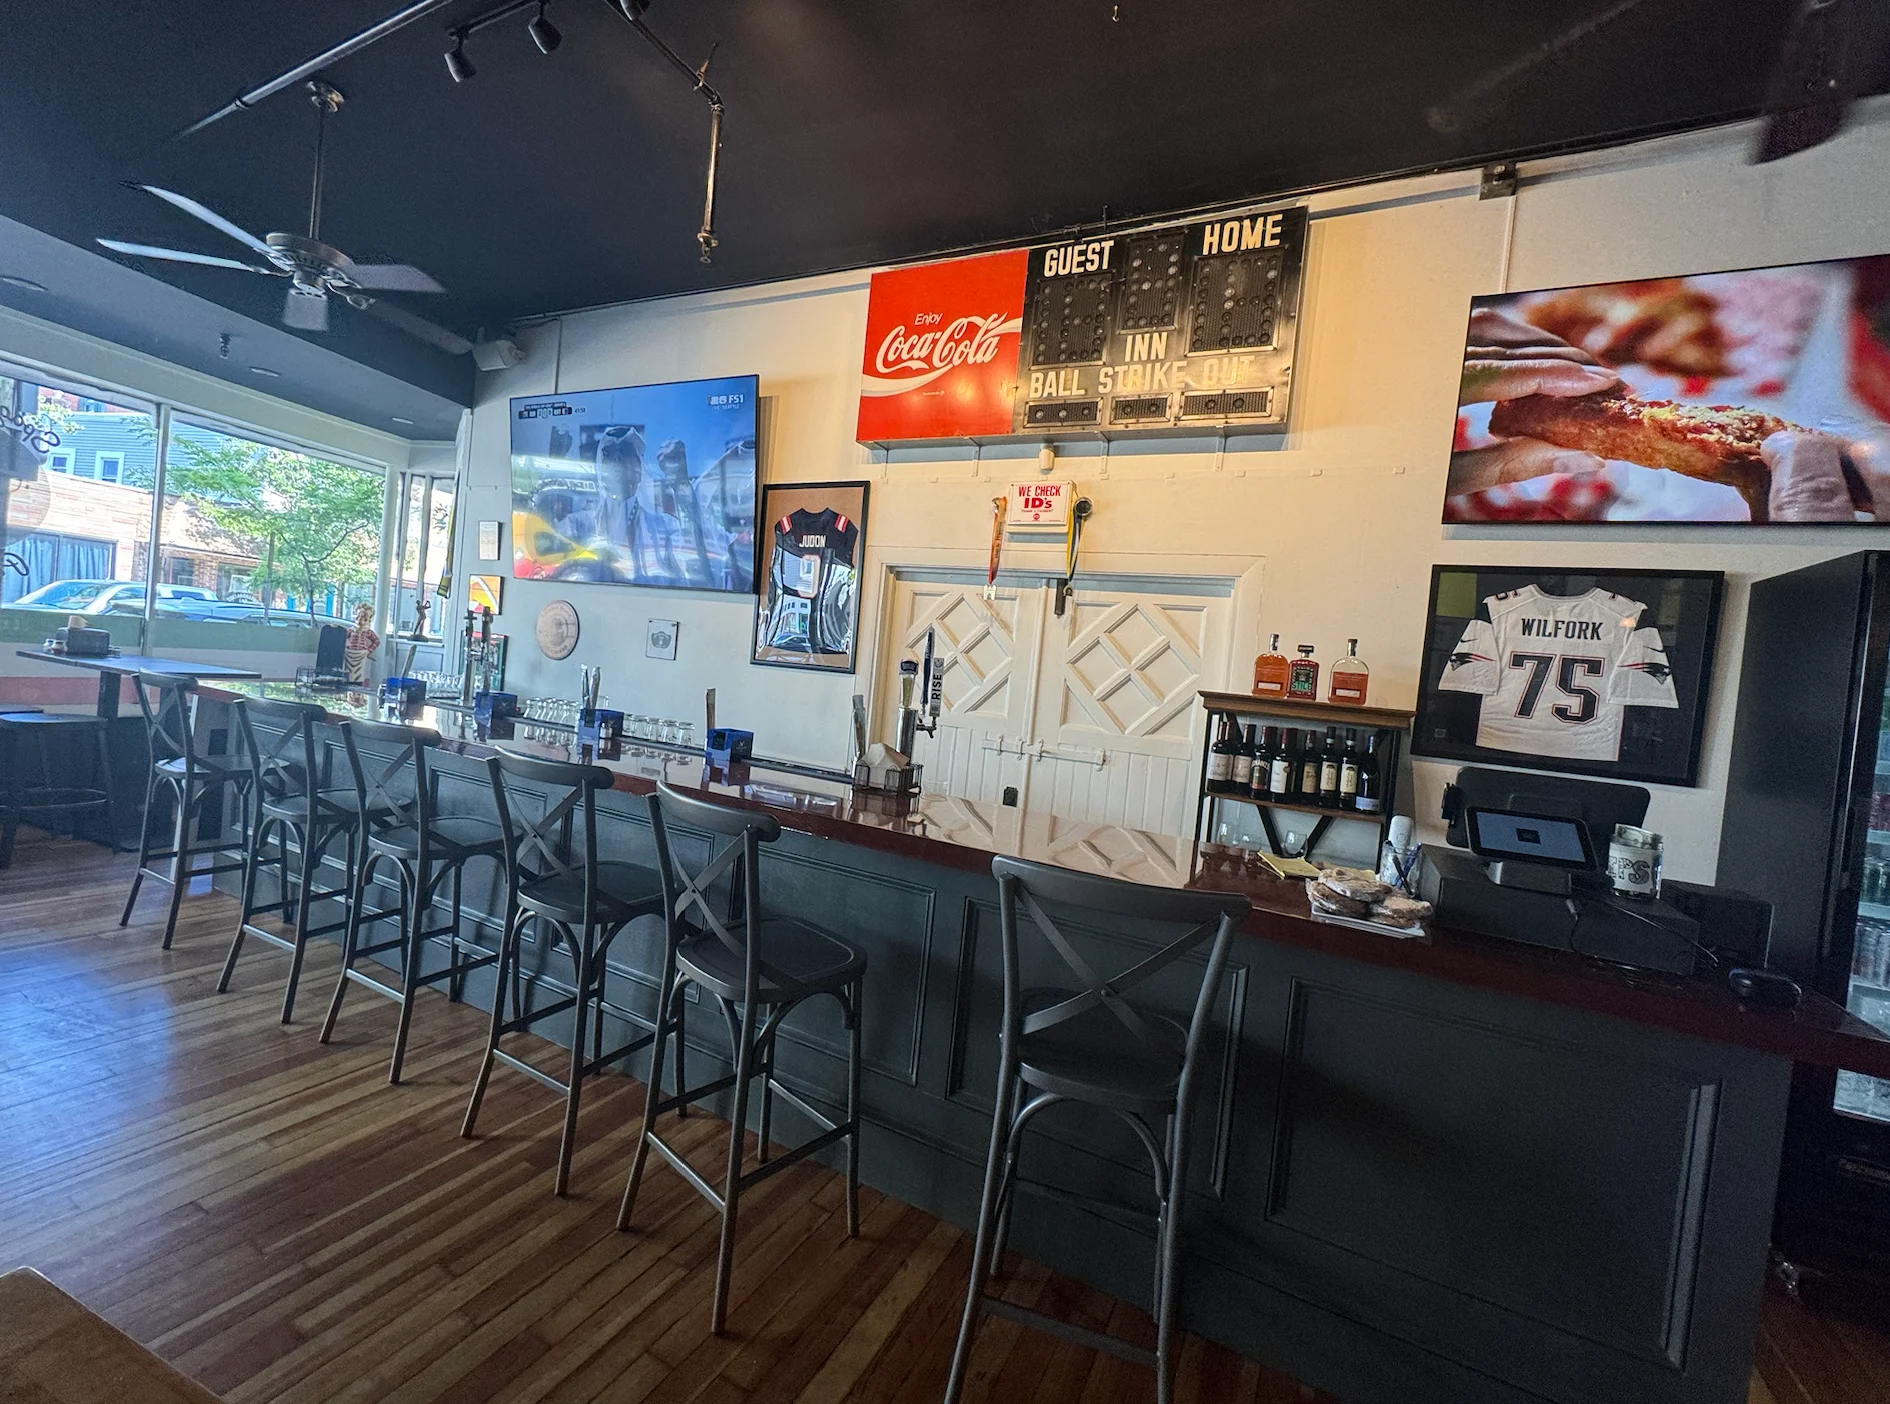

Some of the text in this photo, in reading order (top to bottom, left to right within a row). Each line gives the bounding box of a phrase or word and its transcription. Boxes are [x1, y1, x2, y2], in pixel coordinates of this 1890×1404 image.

[1202, 213, 1284, 255] HOME
[1044, 240, 1115, 278] GUEST
[914, 312, 943, 326] Enjoy
[876, 312, 1008, 374] Coca-Cola
[1124, 332, 1169, 363] INN
[1029, 355, 1256, 399] BALL STRIKE OUT
[728, 394, 744, 404] FS1
[1018, 485, 1062, 497] WE CHECK
[1024, 497, 1053, 509] ID's
[798, 535, 827, 548] JUDON
[1521, 618, 1603, 641] WILFORK
[931, 673, 942, 701] RISE
[1508, 650, 1606, 725] 75
